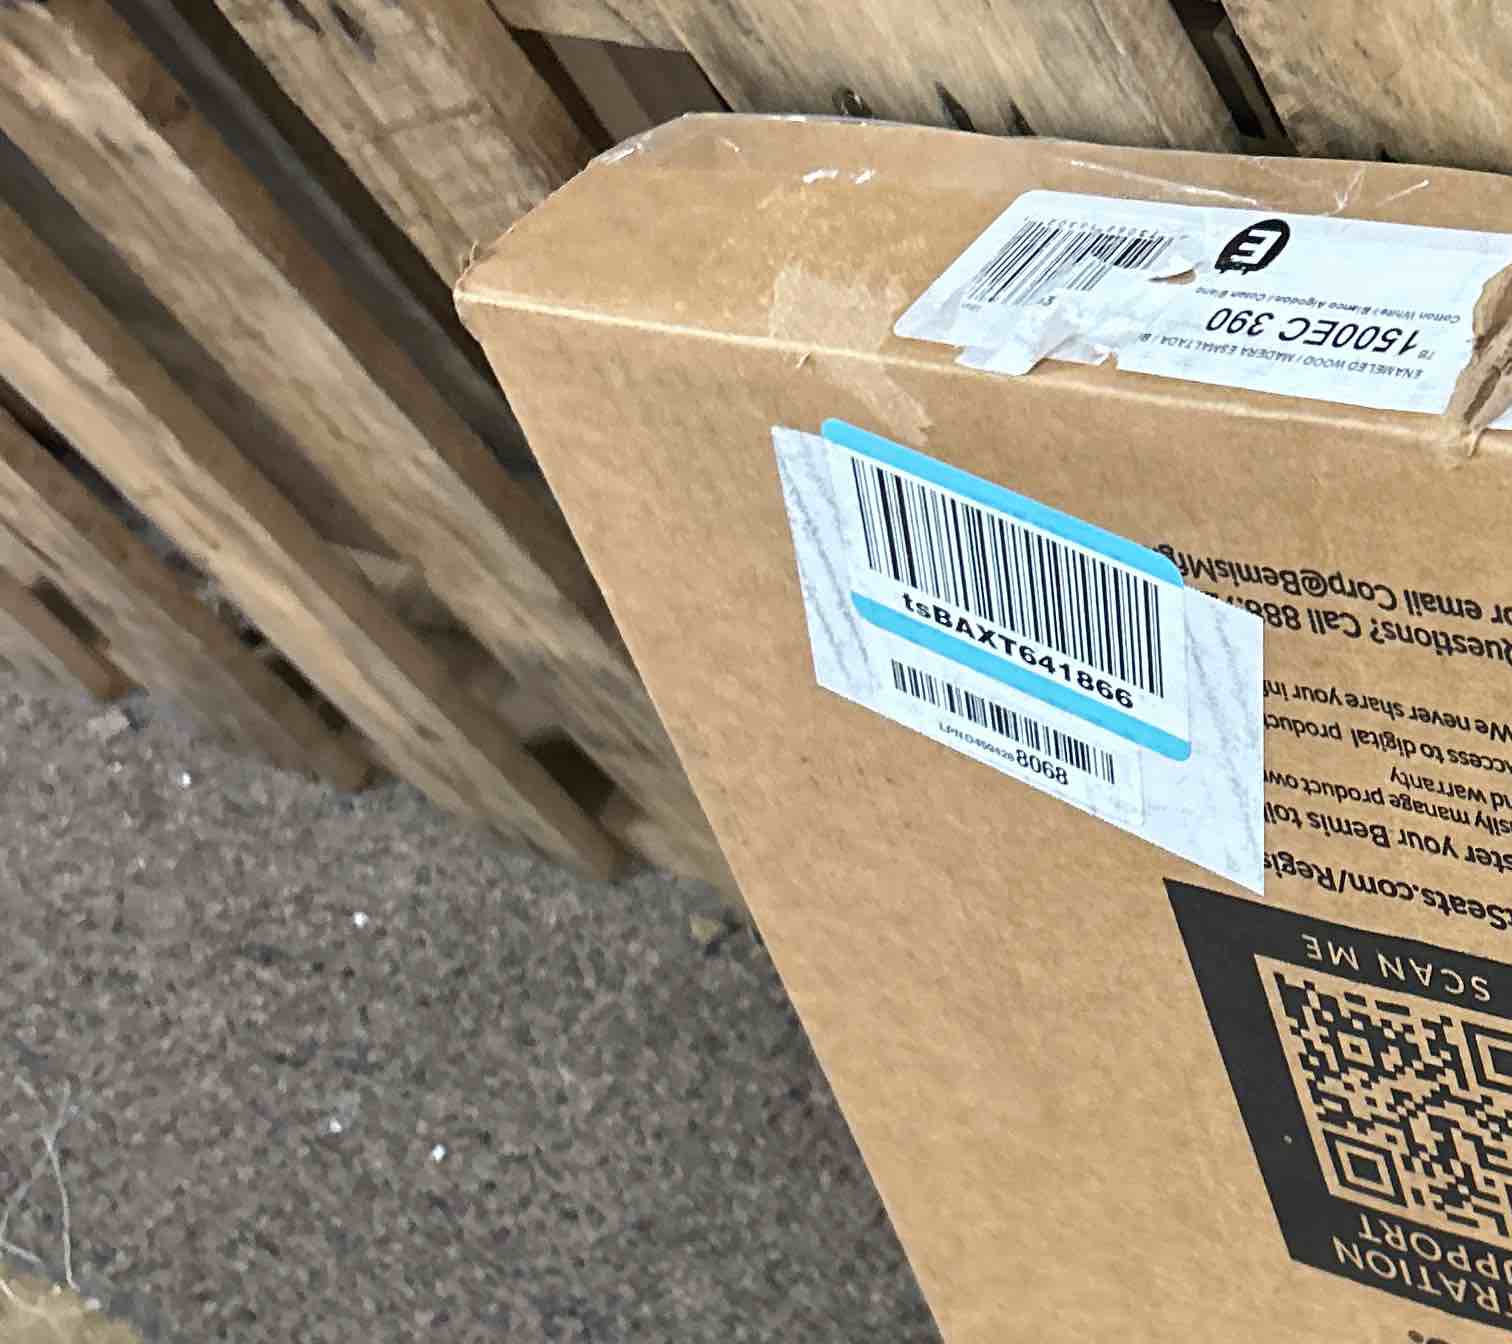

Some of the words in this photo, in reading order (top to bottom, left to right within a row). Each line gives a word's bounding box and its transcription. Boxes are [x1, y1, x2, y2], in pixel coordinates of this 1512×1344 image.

[1205, 308, 1274, 336] 390
[1379, 308, 1416, 321] White
[1419, 311, 1461, 324] Cotton
[1161, 335, 1238, 354] ESMALTADA
[1278, 317, 1420, 356] 1500EC
[1240, 347, 1296, 363] MADERA
[1303, 355, 1346, 370] WOOD
[1348, 362, 1424, 379] ENAMELED
[1403, 589, 1482, 623] email
[1307, 607, 1361, 639] Call
[902, 592, 1134, 708] tsBAXT641866
[1292, 684, 1343, 706] your
[1344, 693, 1405, 721] share
[1408, 706, 1471, 732] never
[1351, 729, 1417, 759] digital
[1420, 743, 1445, 765] to
[1300, 777, 1385, 806] product
[1390, 766, 1487, 804] warranty
[1389, 793, 1471, 826] manage
[1306, 811, 1391, 849] Bemis
[1397, 829, 1459, 861] your
[1301, 934, 1359, 970] ME
[1376, 952, 1491, 1002] SCAN
